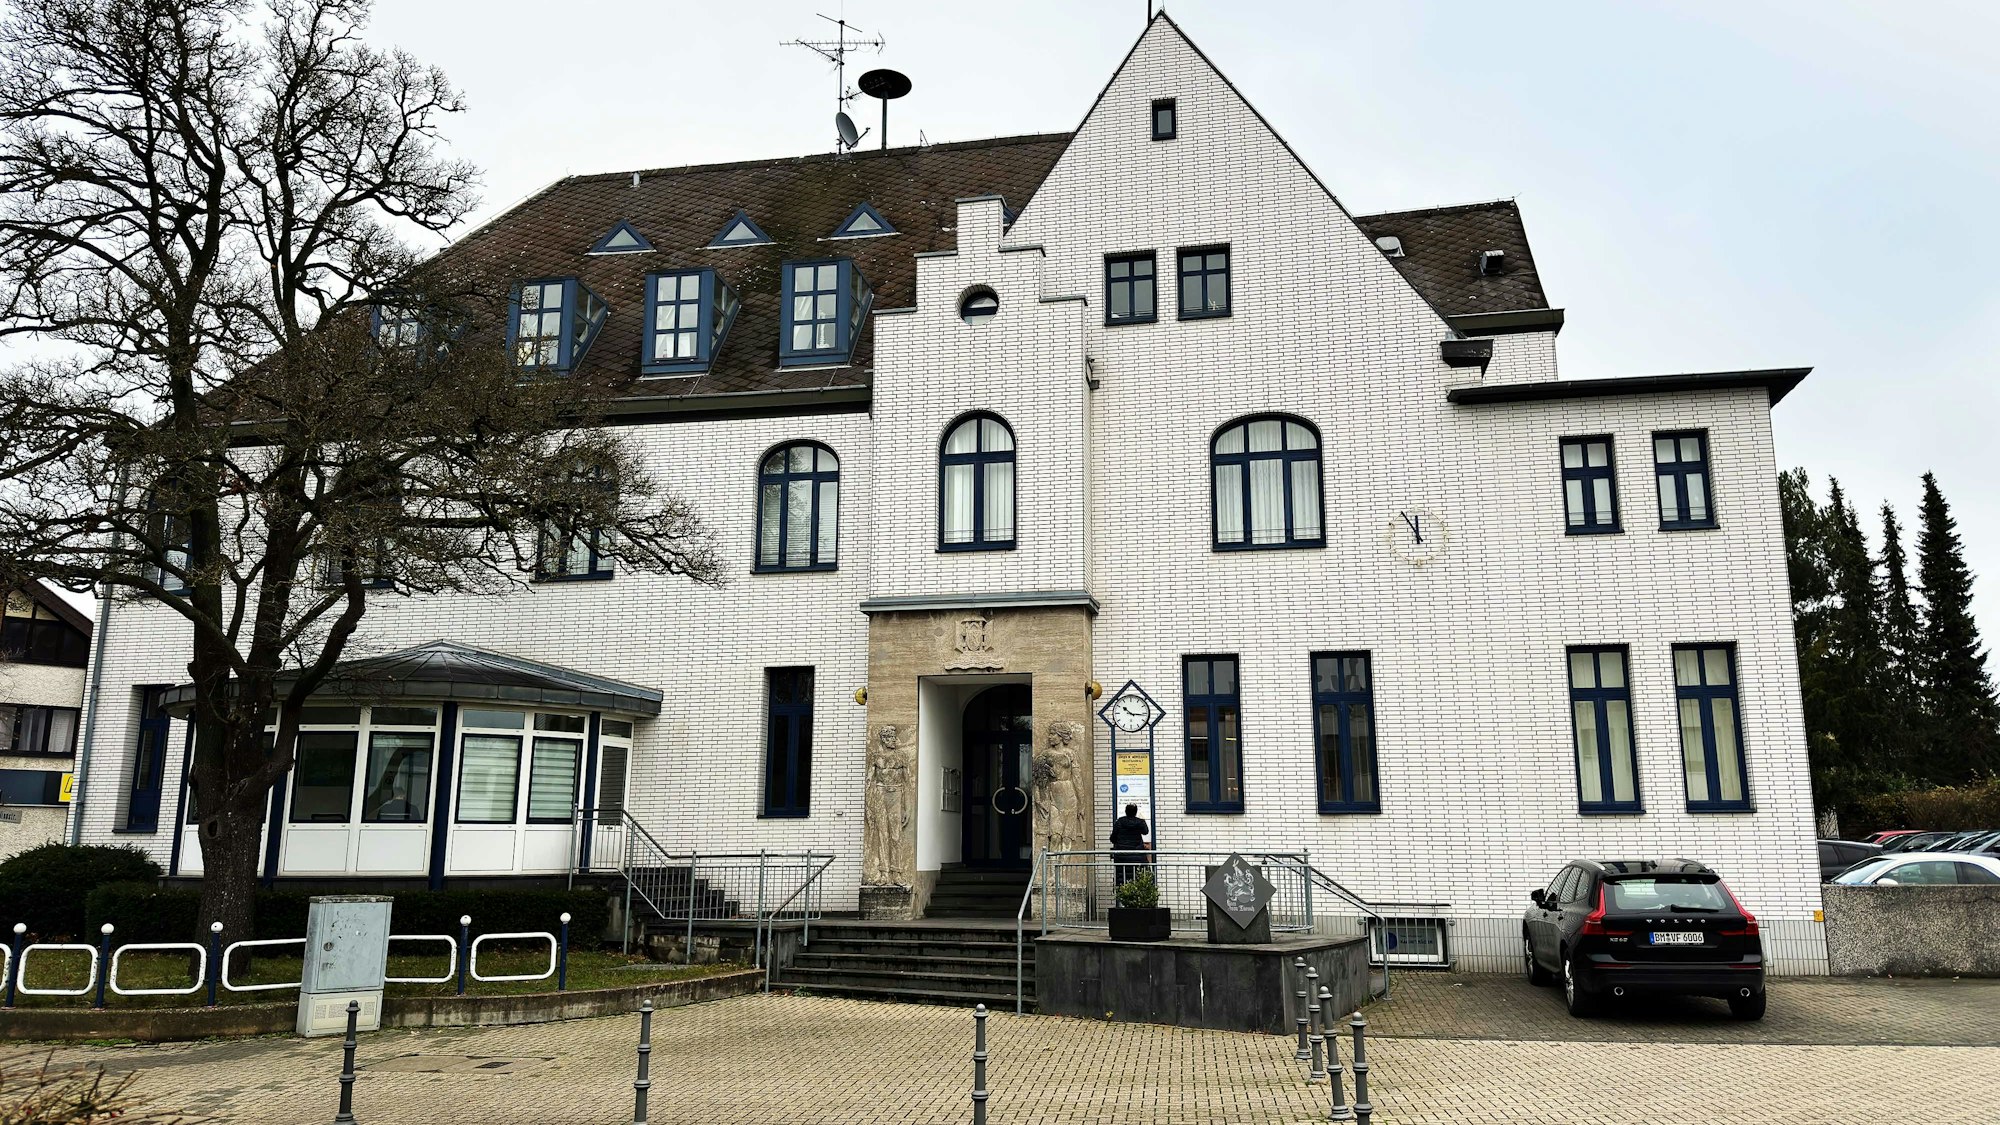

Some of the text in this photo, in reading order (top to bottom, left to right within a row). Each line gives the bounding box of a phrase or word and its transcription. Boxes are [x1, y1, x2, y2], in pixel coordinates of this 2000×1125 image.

[1654, 932, 1703, 942] BM VF 6006
